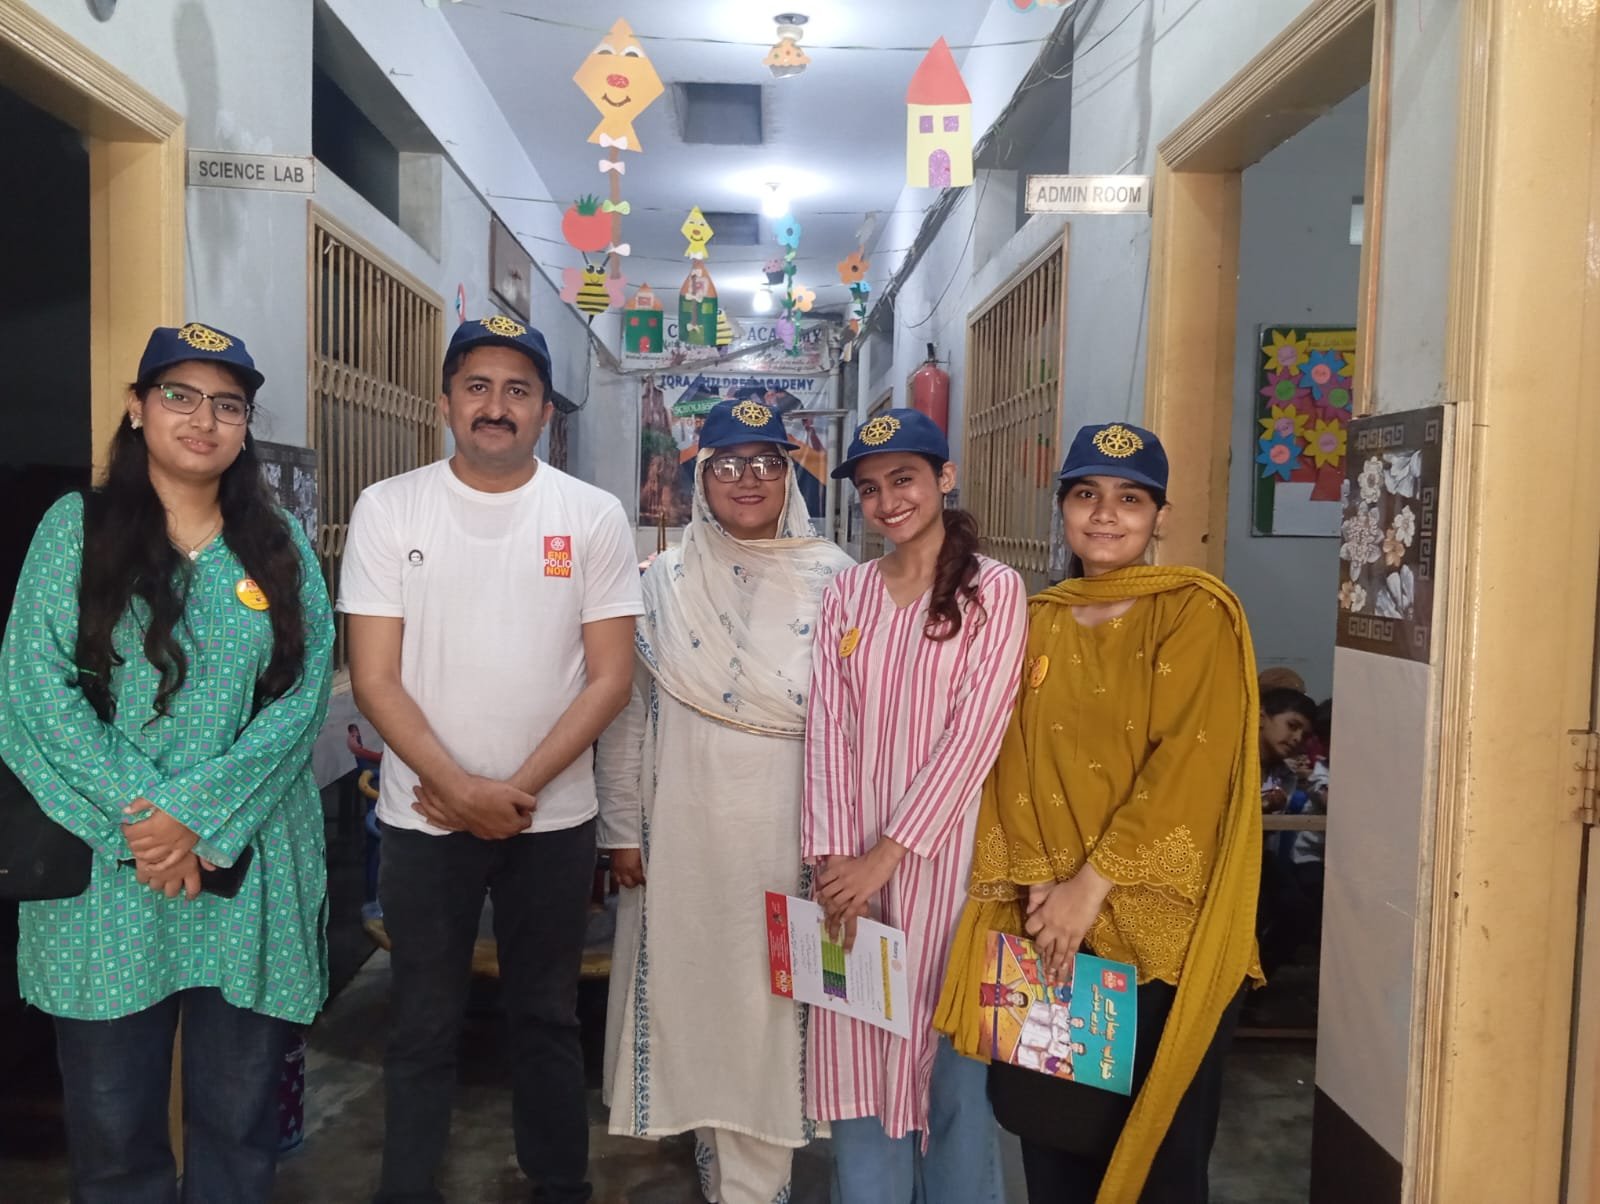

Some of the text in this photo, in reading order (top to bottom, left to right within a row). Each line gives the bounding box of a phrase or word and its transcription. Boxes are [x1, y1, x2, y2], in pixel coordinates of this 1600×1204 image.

[199, 160, 304, 182] SCIENCE LAB
[1037, 186, 1142, 203] ADMIN ROOM
[747, 327, 822, 343] ACAMY
[661, 375, 690, 389] IQRA
[547, 551, 569, 560] END
[544, 559, 571, 568] POLIO
[546, 567, 569, 576] NOW
